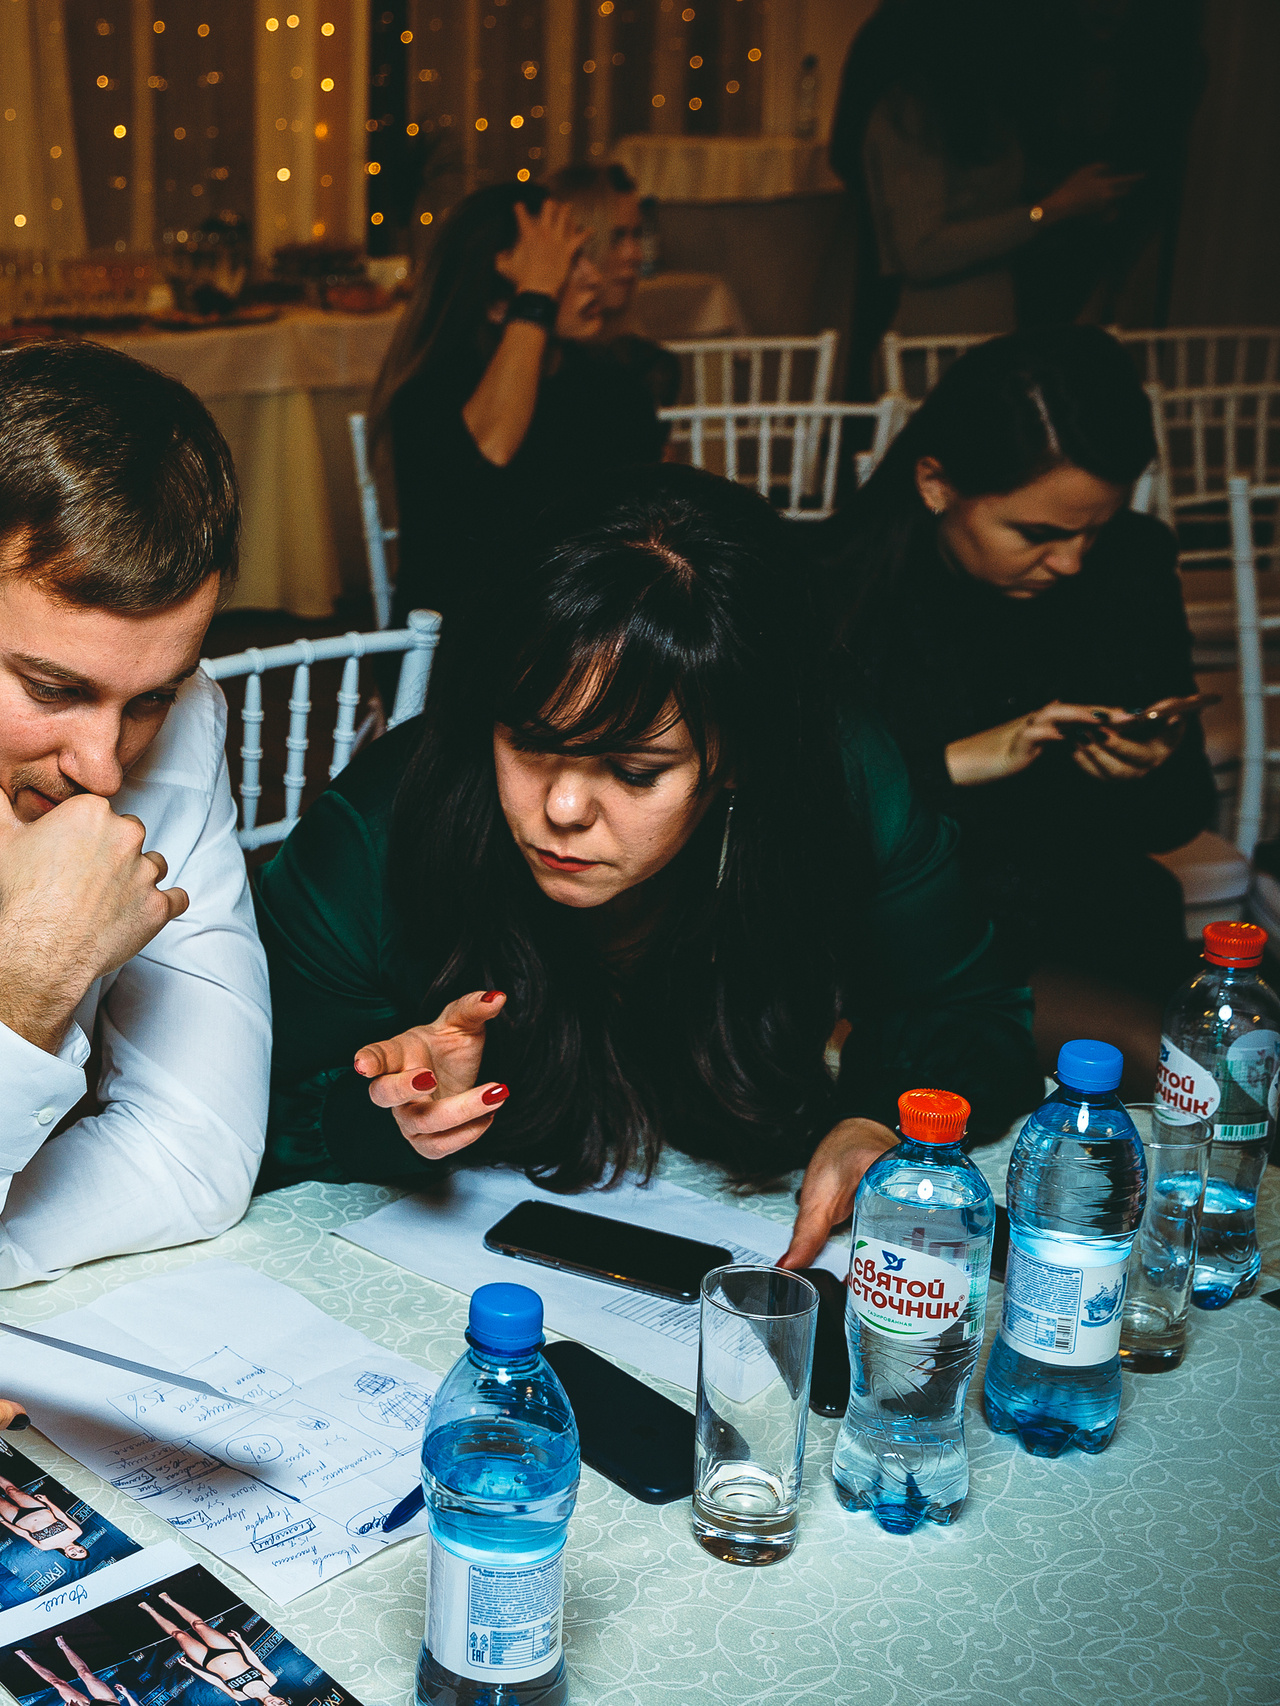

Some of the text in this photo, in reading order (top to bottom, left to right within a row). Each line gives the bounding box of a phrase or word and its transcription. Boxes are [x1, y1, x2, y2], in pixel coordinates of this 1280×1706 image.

[1159, 1063, 1195, 1095] ТОЙ
[1155, 1082, 1209, 1116] ЧНИК
[854, 1257, 945, 1299] СВЯТОЙ
[867, 1309, 913, 1327] ГАЗИРОВАННАЯ
